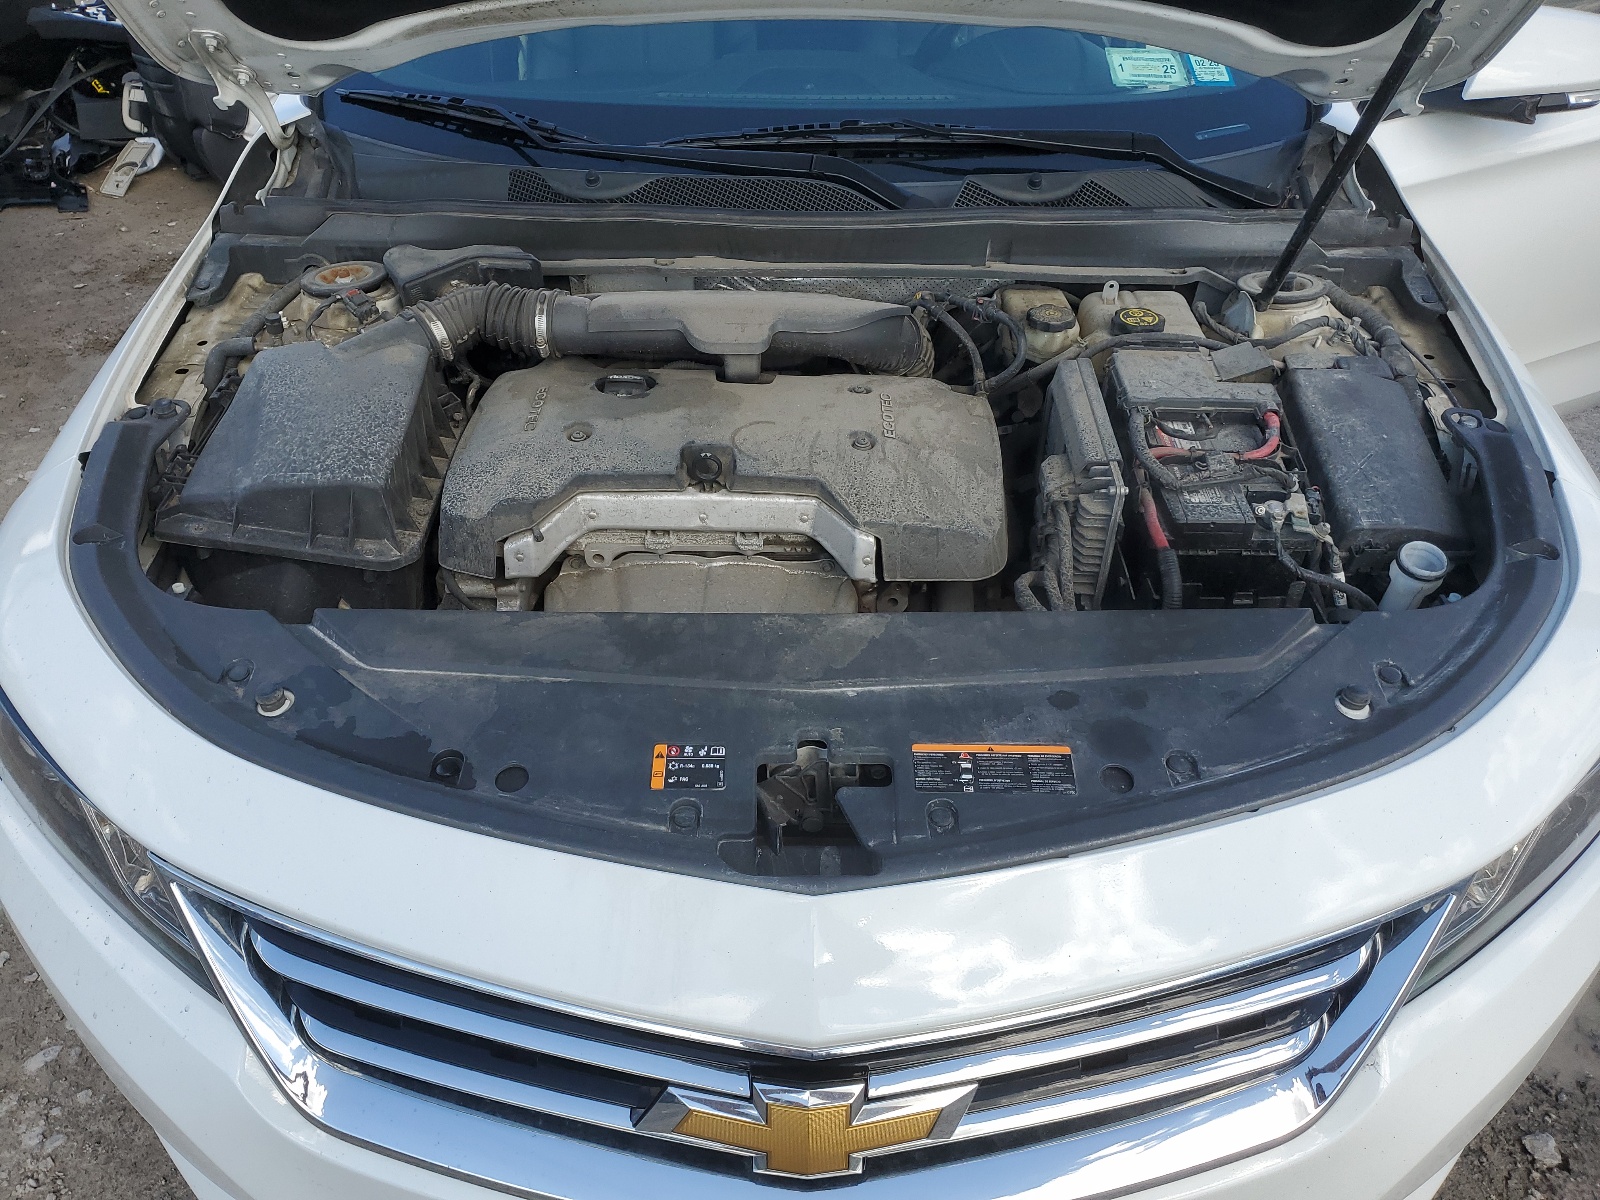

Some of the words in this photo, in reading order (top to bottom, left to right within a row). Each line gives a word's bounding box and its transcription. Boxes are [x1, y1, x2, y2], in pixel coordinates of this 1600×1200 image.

[1118, 63, 1125, 72] 1
[1162, 64, 1177, 74] 25
[524, 386, 548, 431] ECOTEC
[880, 392, 896, 439] ECOTEC
